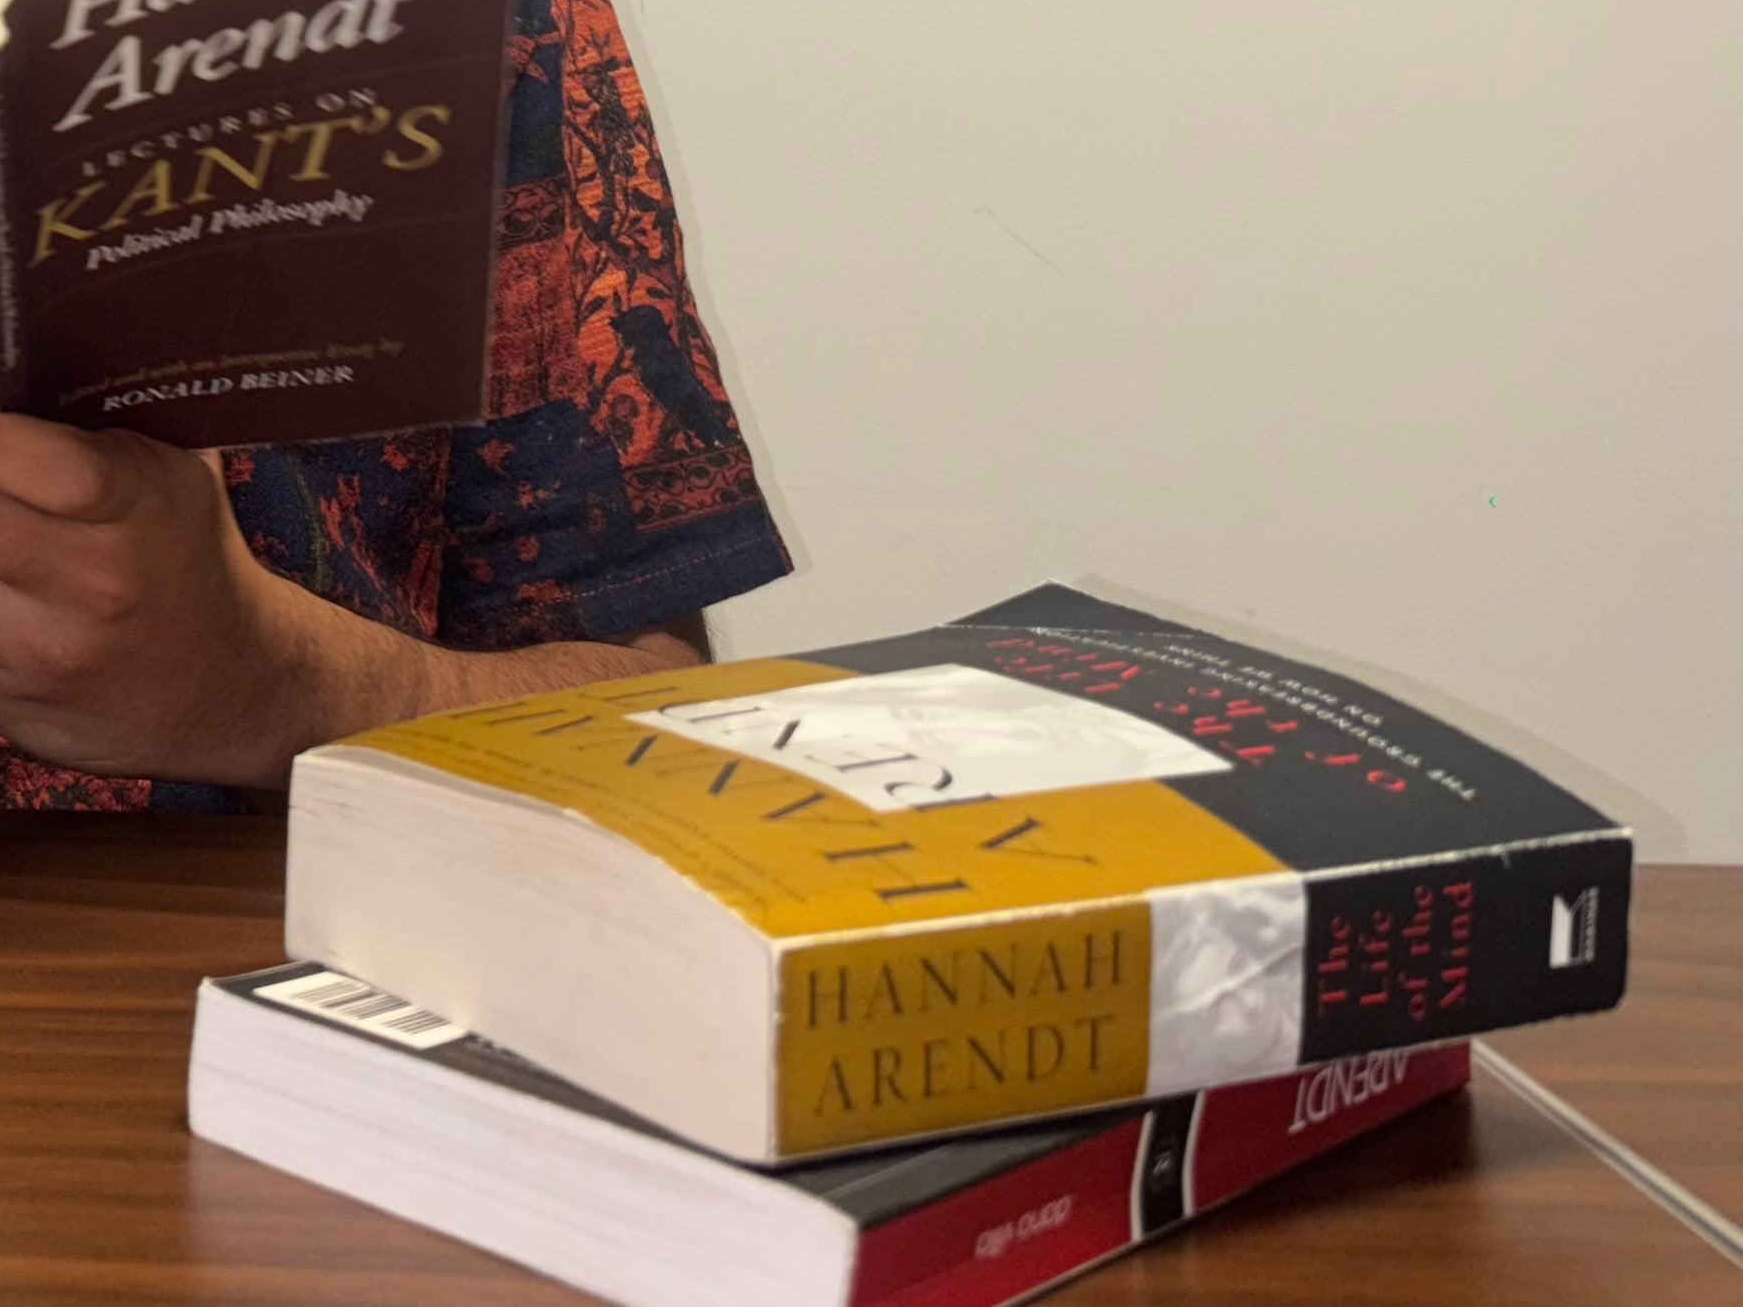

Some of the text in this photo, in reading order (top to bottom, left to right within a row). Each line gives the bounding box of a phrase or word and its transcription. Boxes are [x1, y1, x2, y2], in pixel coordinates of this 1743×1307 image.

[81, 87, 379, 178] LECTURES ON
[28, 104, 453, 270] KANT'S
[85, 188, 375, 273] Political Philosophy
[102, 376, 236, 412] RONALD
[238, 364, 355, 392] BEINER
[1153, 699, 1276, 765] The
[1162, 644, 1384, 727] ON HOW WE THINK
[452, 701, 970, 908] HANNAH
[579, 683, 1099, 866] ARENDT
[1426, 768, 1479, 802] THE
[806, 929, 1126, 1031] HANNAH
[1315, 915, 1355, 1021] The
[1359, 908, 1395, 1007] Life
[1399, 884, 1434, 1023] of the
[1439, 881, 1476, 1009] Mind
[815, 1013, 1117, 1117] ARENDT
